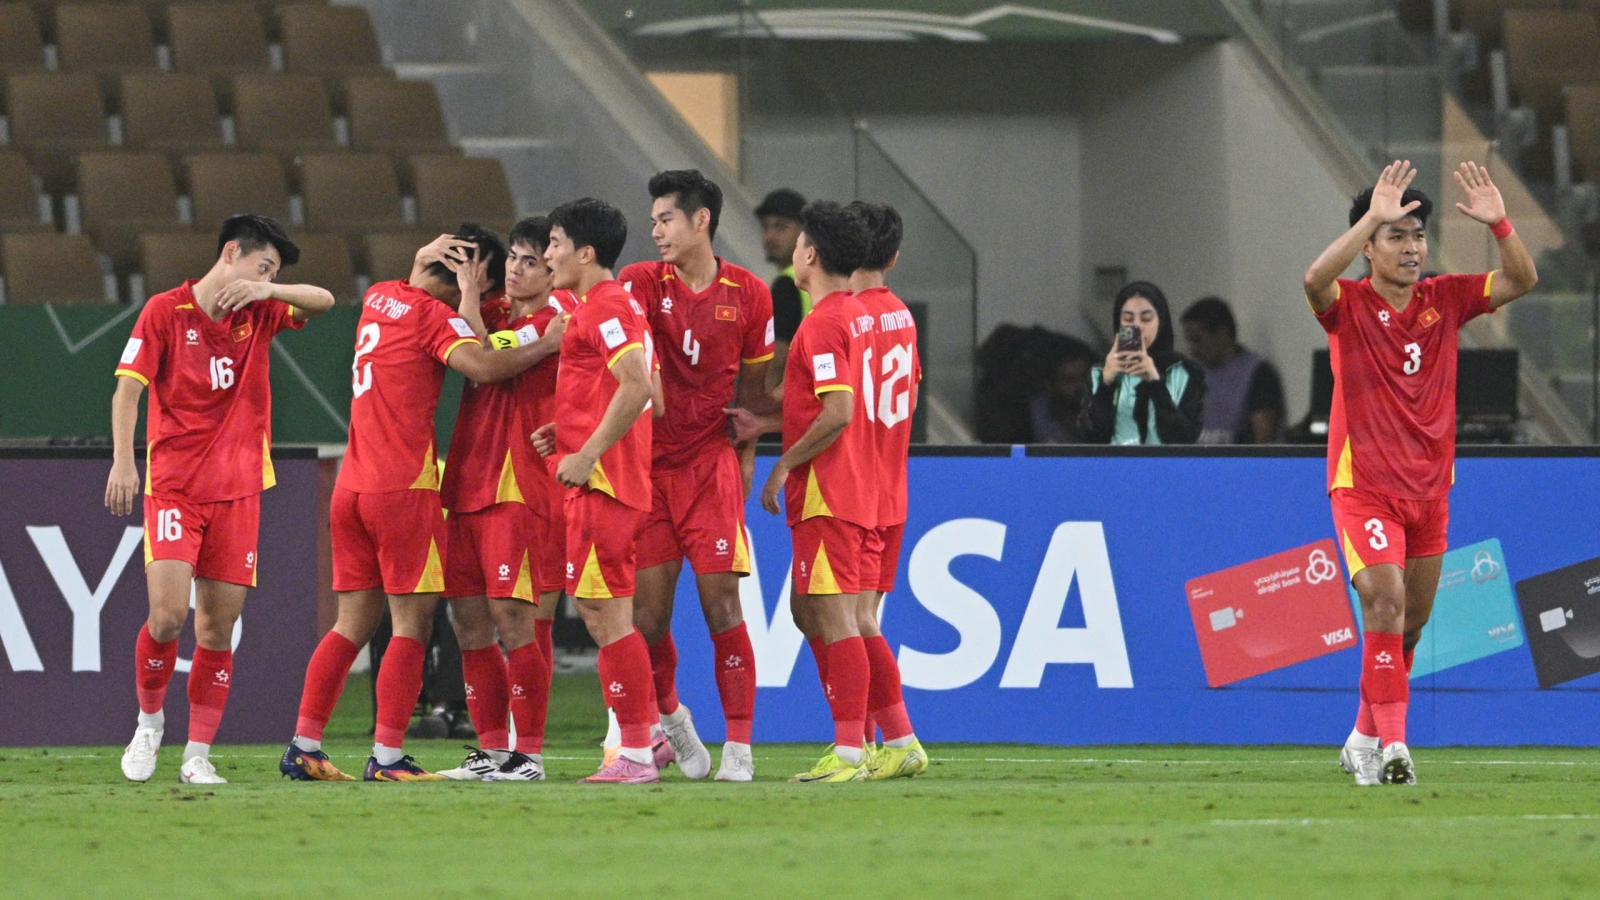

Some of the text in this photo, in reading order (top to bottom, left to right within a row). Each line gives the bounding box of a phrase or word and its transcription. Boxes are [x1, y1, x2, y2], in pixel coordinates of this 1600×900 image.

[682, 329, 701, 365] 4
[1403, 342, 1422, 375] 3
[209, 356, 235, 391] 16
[156, 507, 183, 543] 16
[1364, 517, 1389, 551] 3
[739, 517, 1134, 690] VSA
[1320, 627, 1353, 646] VISA
